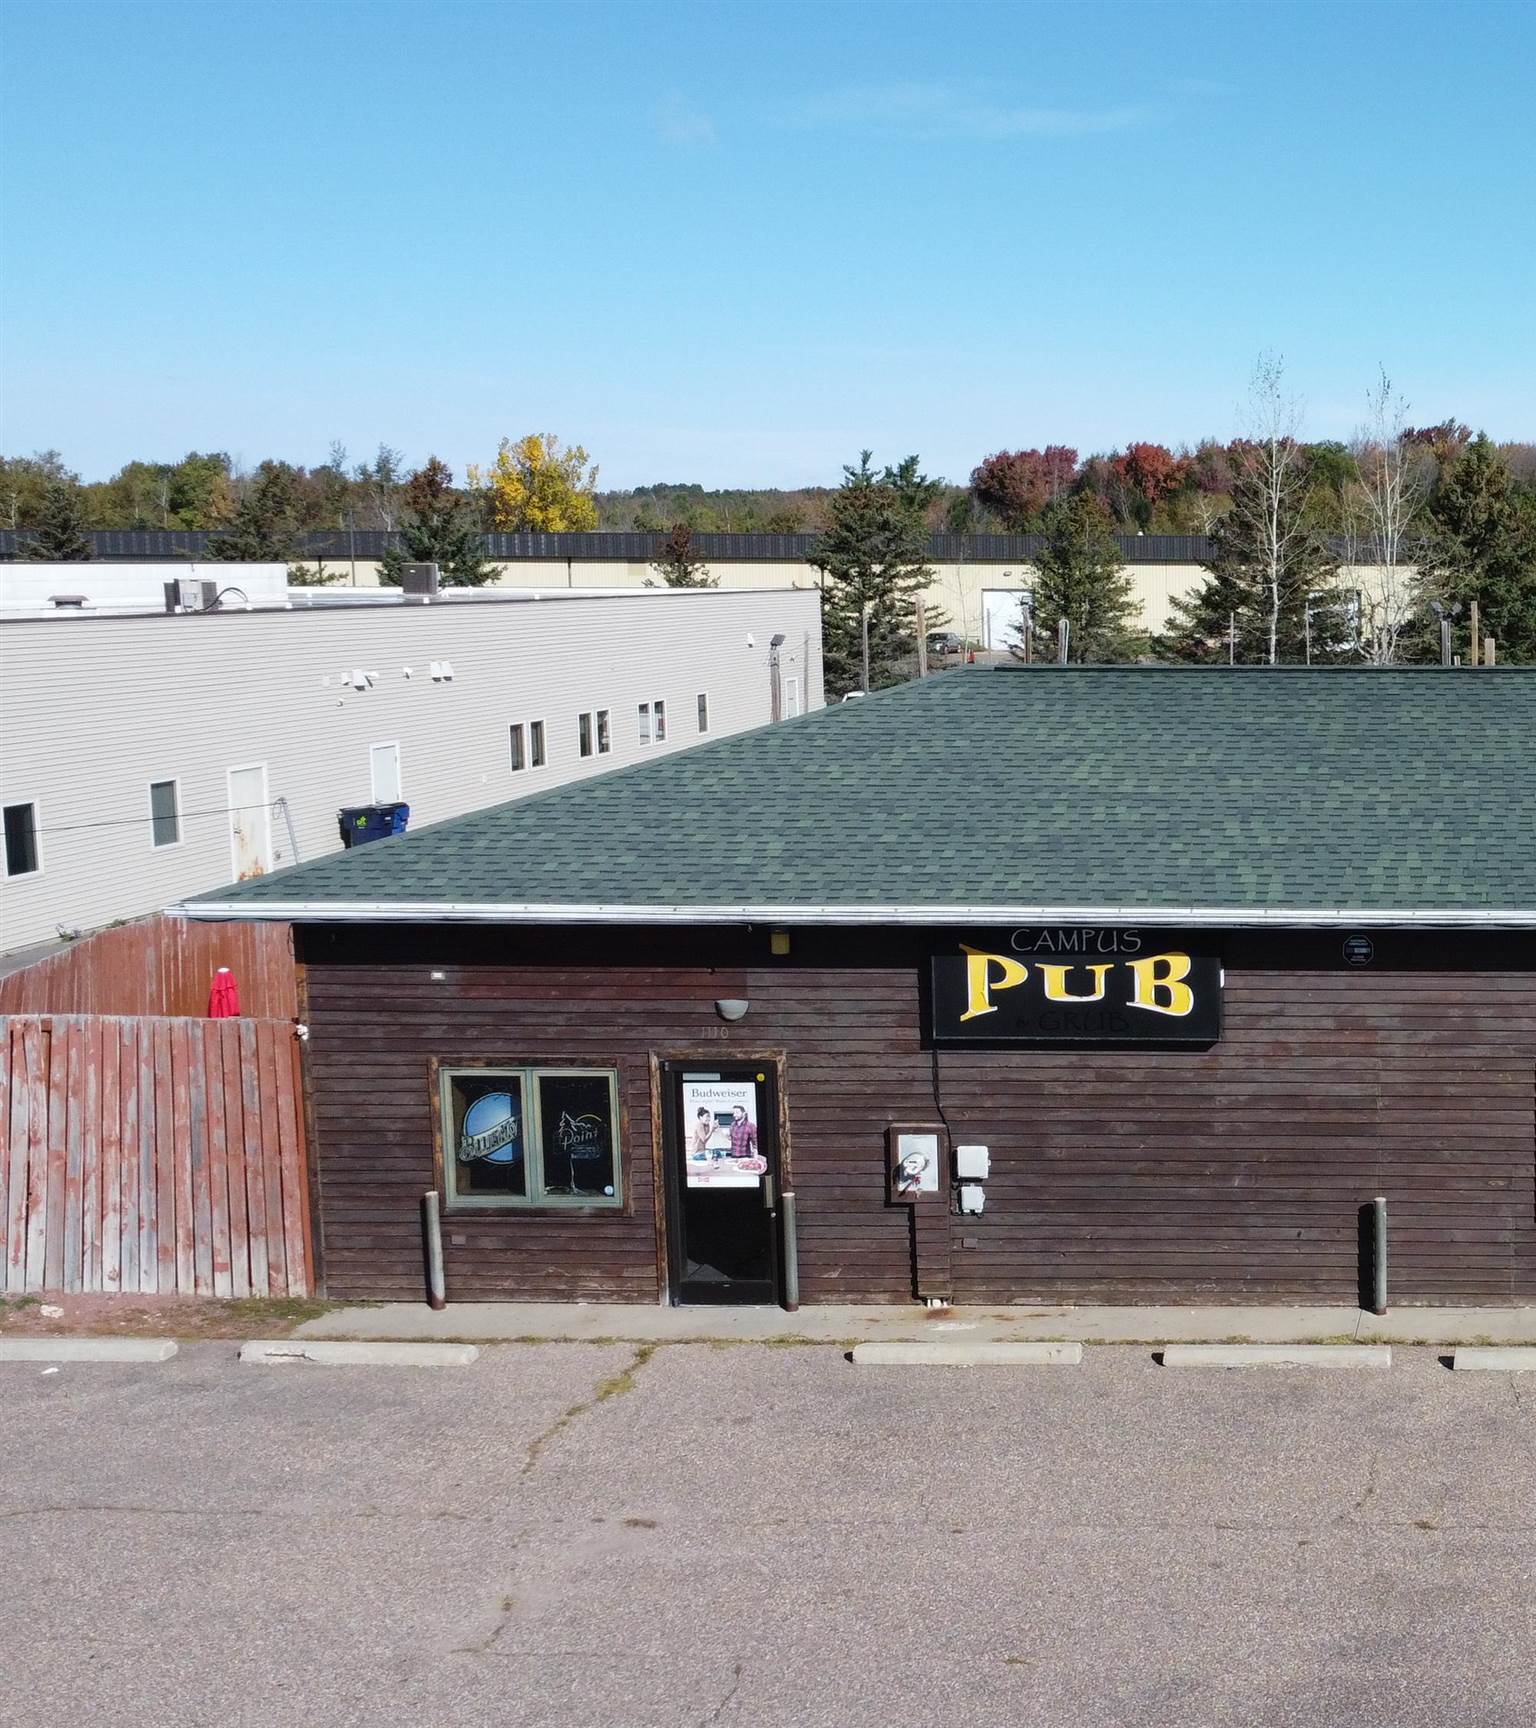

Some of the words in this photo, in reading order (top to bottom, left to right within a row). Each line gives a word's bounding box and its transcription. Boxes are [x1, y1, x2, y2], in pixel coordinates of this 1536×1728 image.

[1010, 928, 1142, 952] CAMPUS
[959, 943, 1194, 1022] PUB
[1038, 1009, 1131, 1034] GRUB
[691, 1087, 748, 1098] Budweiser
[558, 1127, 599, 1152] Point
